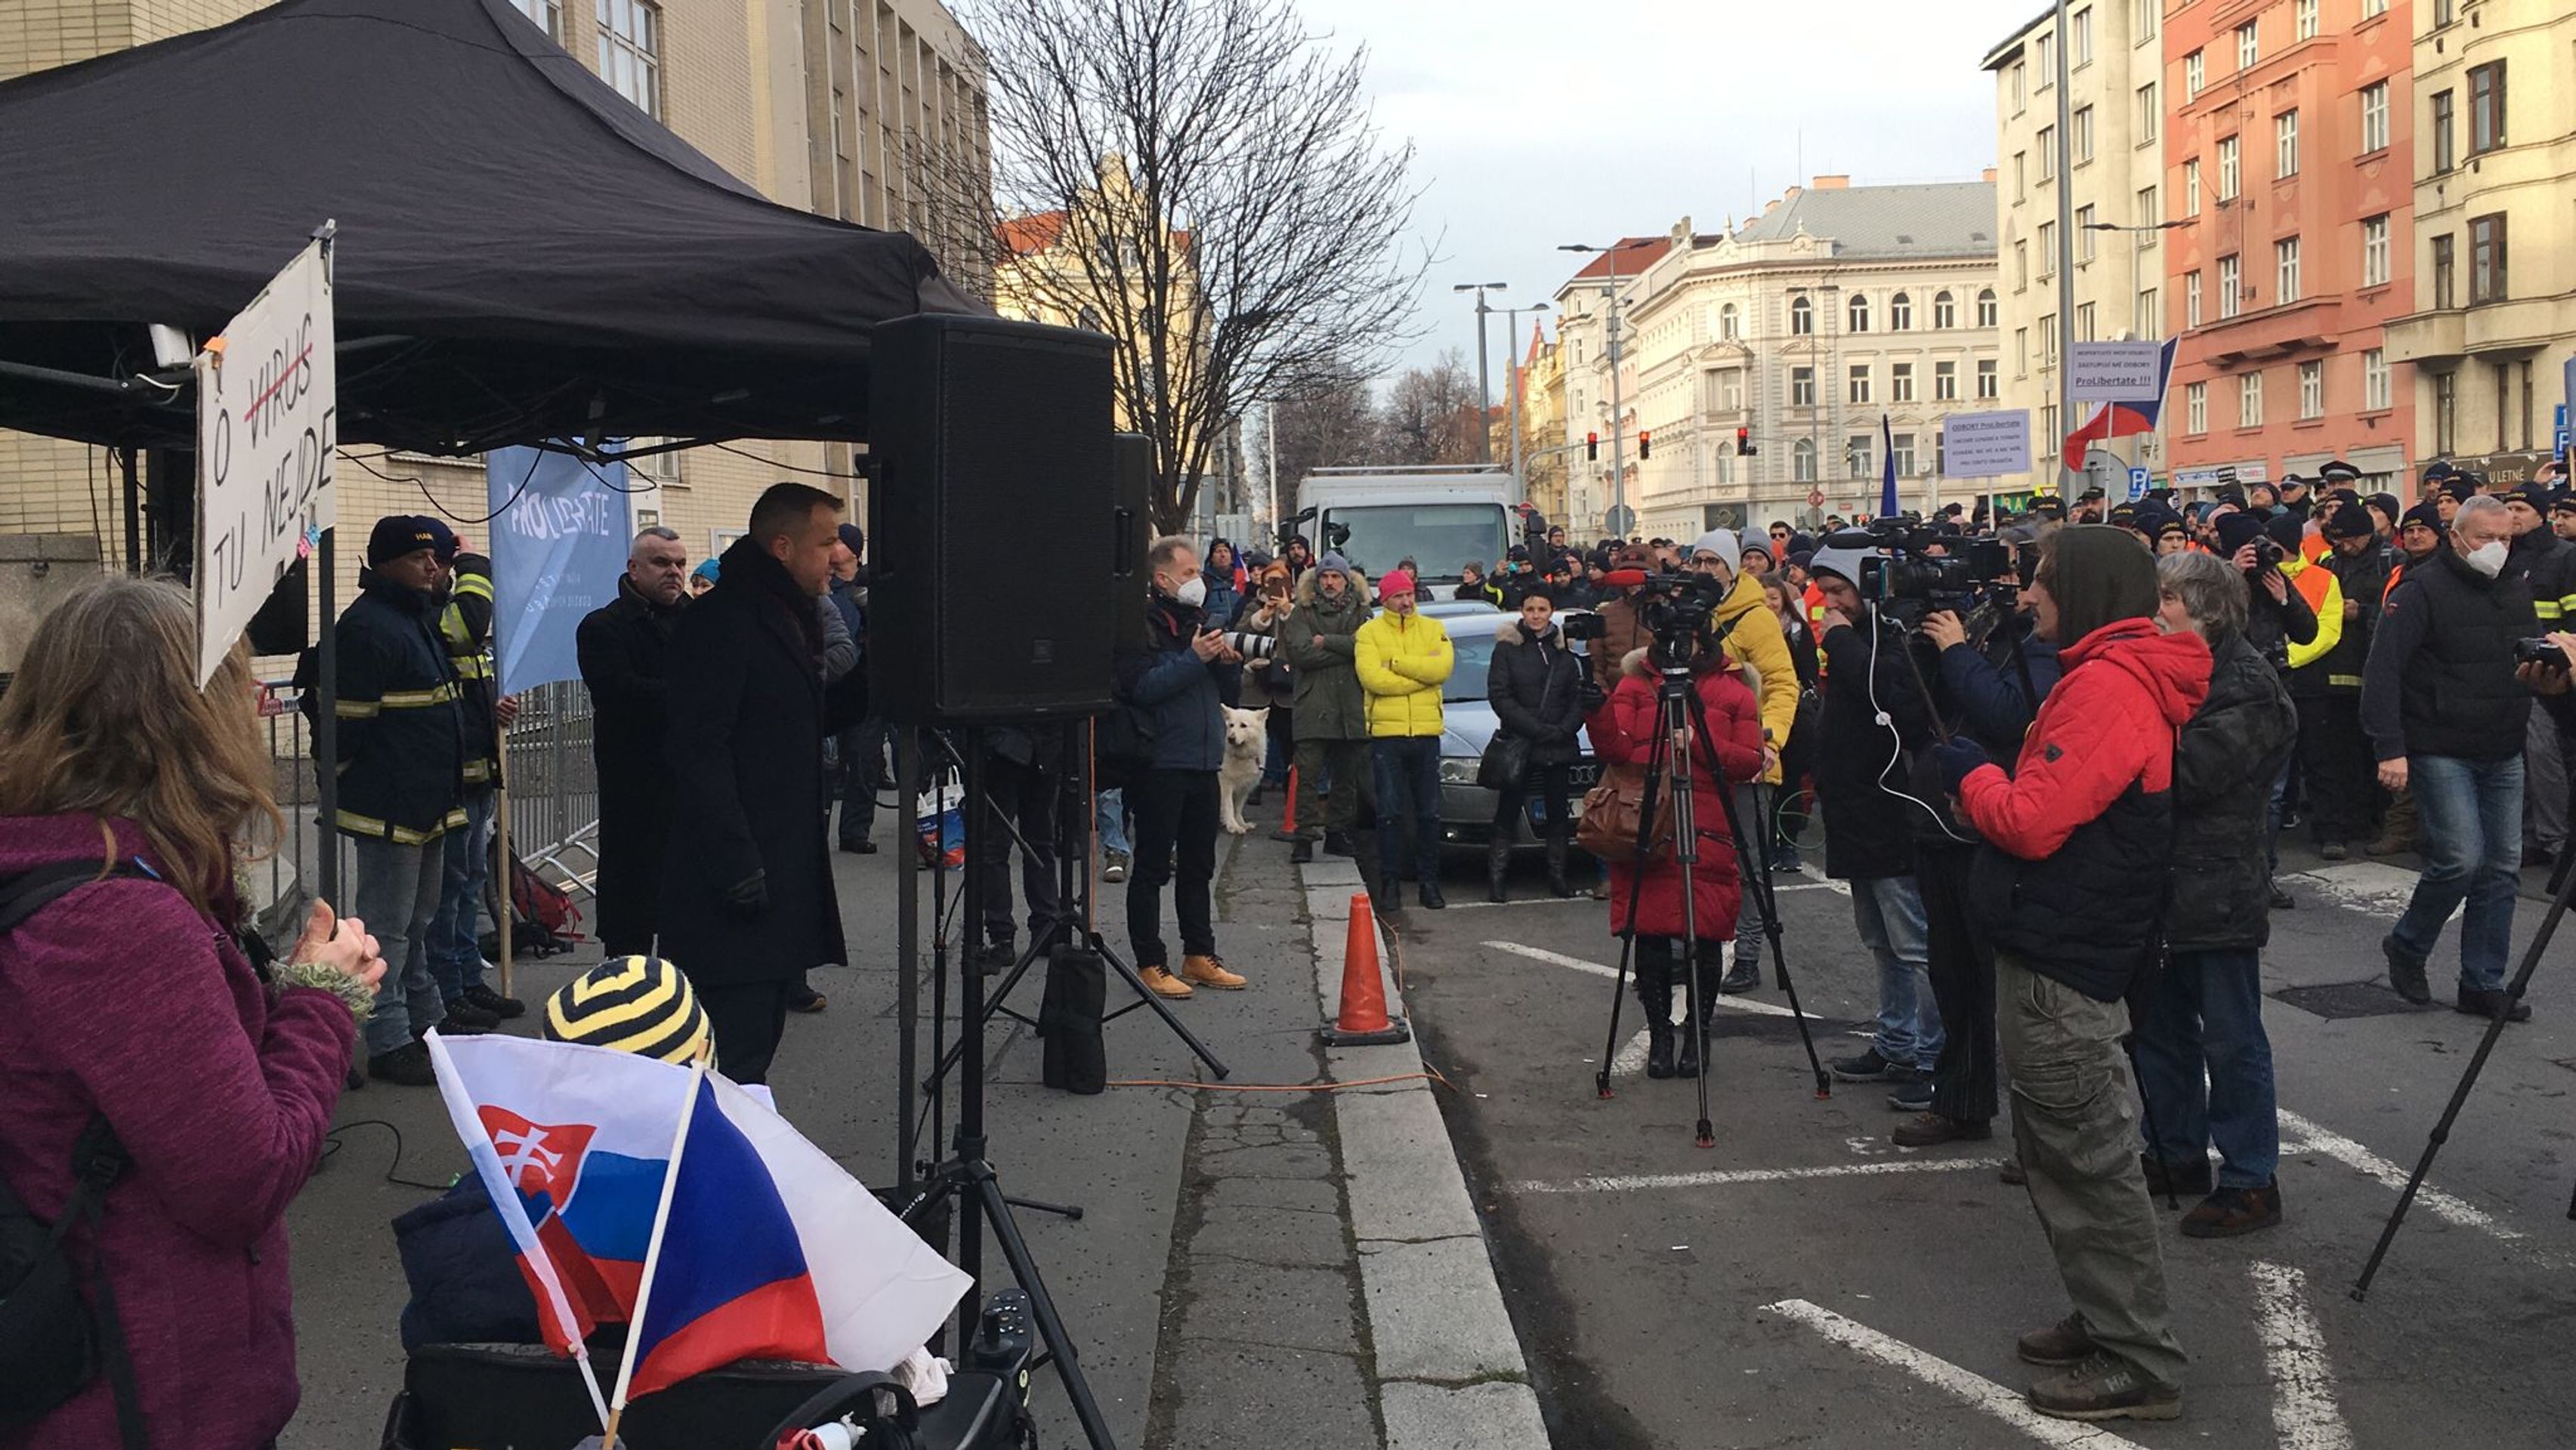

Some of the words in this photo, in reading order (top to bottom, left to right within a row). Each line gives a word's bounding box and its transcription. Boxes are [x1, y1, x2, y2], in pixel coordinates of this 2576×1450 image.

[249, 312, 313, 449] VIRUS
[2075, 375, 2136, 387] ProLibertate
[2133, 470, 2145, 489] P
[2488, 471, 2495, 483] U
[2497, 467, 2525, 483] LETNÉ
[213, 511, 246, 609] TU
[261, 406, 335, 557] NEJDE
